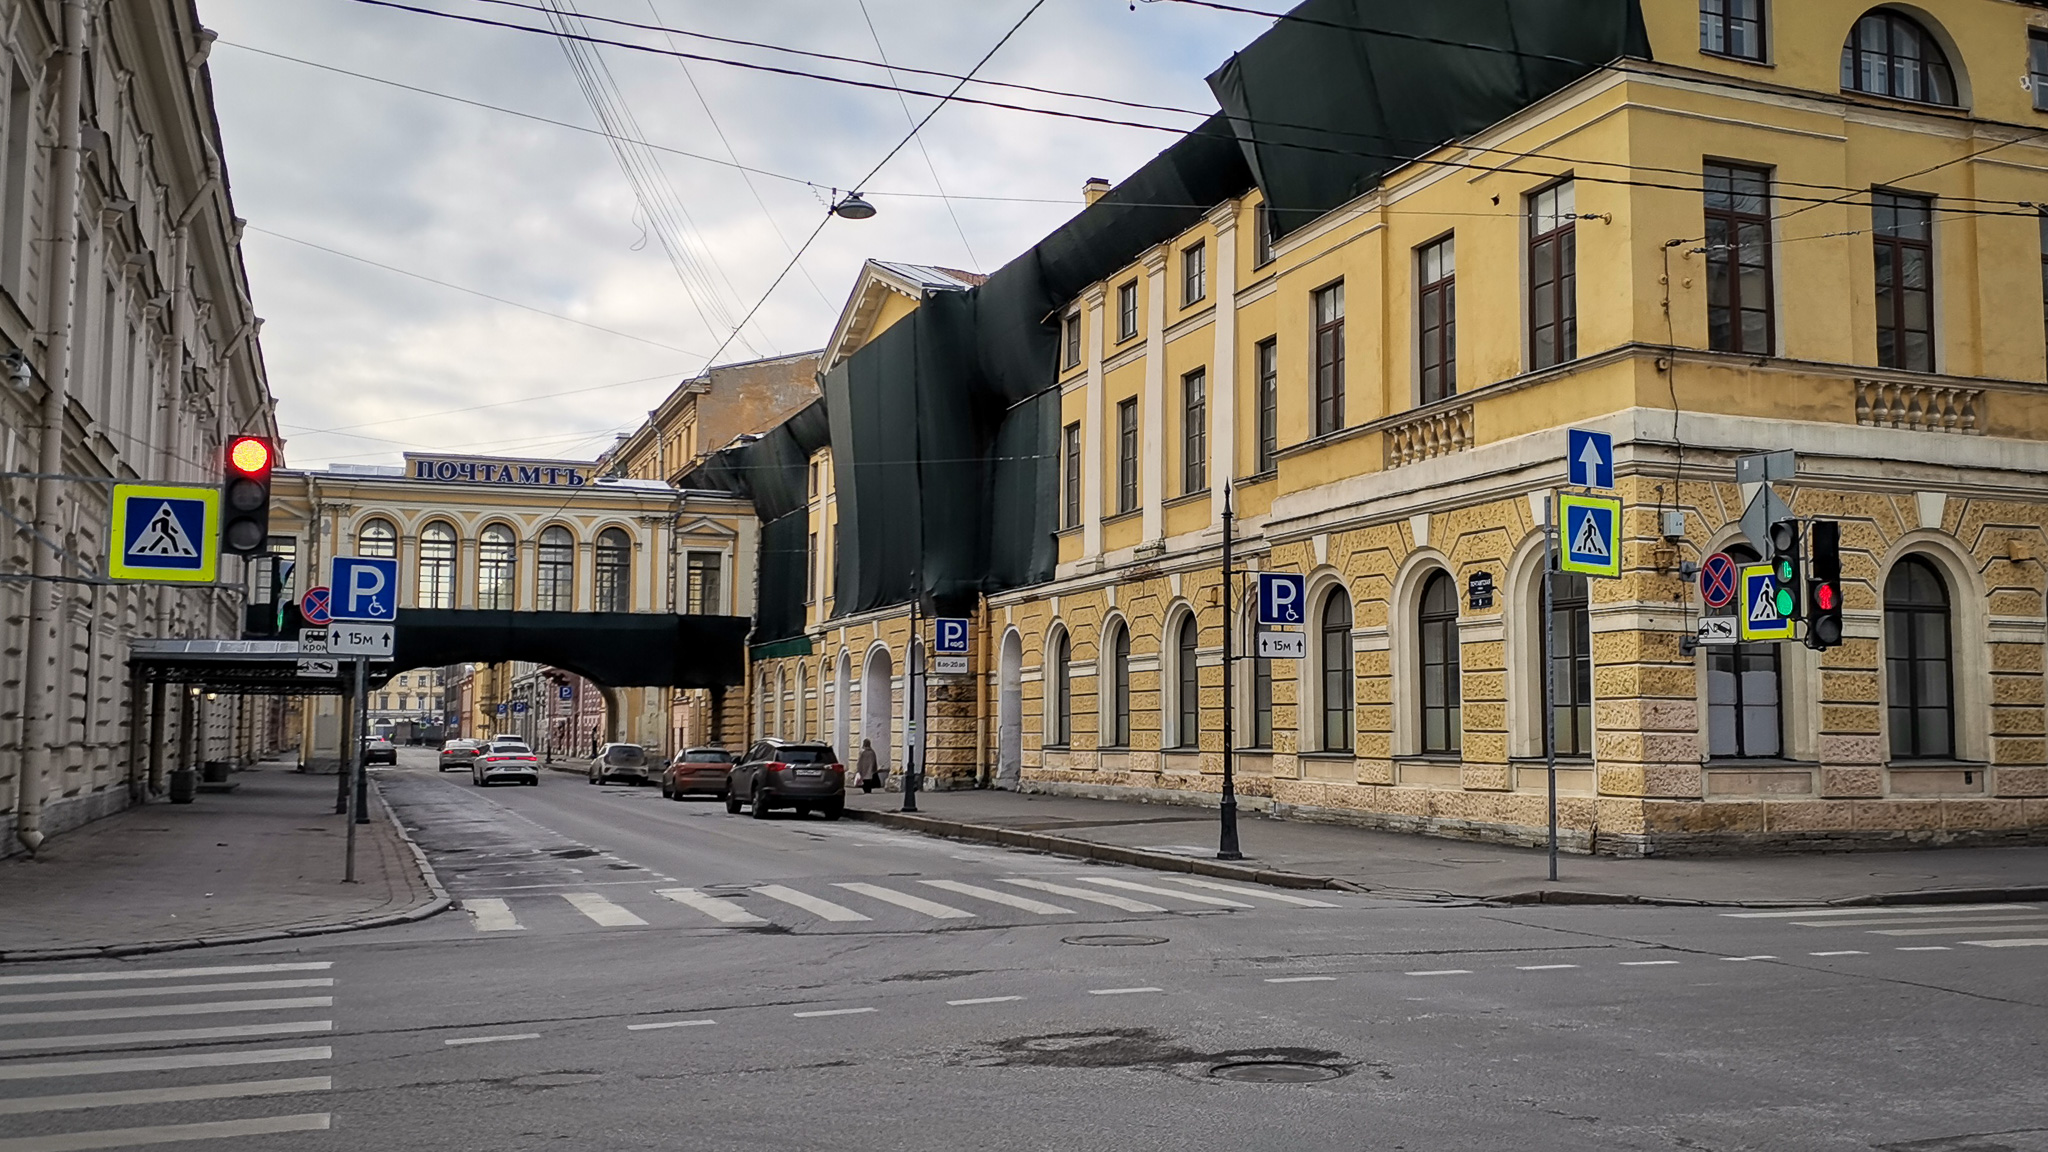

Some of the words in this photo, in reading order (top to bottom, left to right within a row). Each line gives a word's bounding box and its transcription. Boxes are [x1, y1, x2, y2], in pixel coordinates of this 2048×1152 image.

[415, 460, 584, 487] ПОЧТАМТЪ
[348, 564, 385, 612] P
[1271, 578, 1297, 618] P
[944, 622, 962, 648] P
